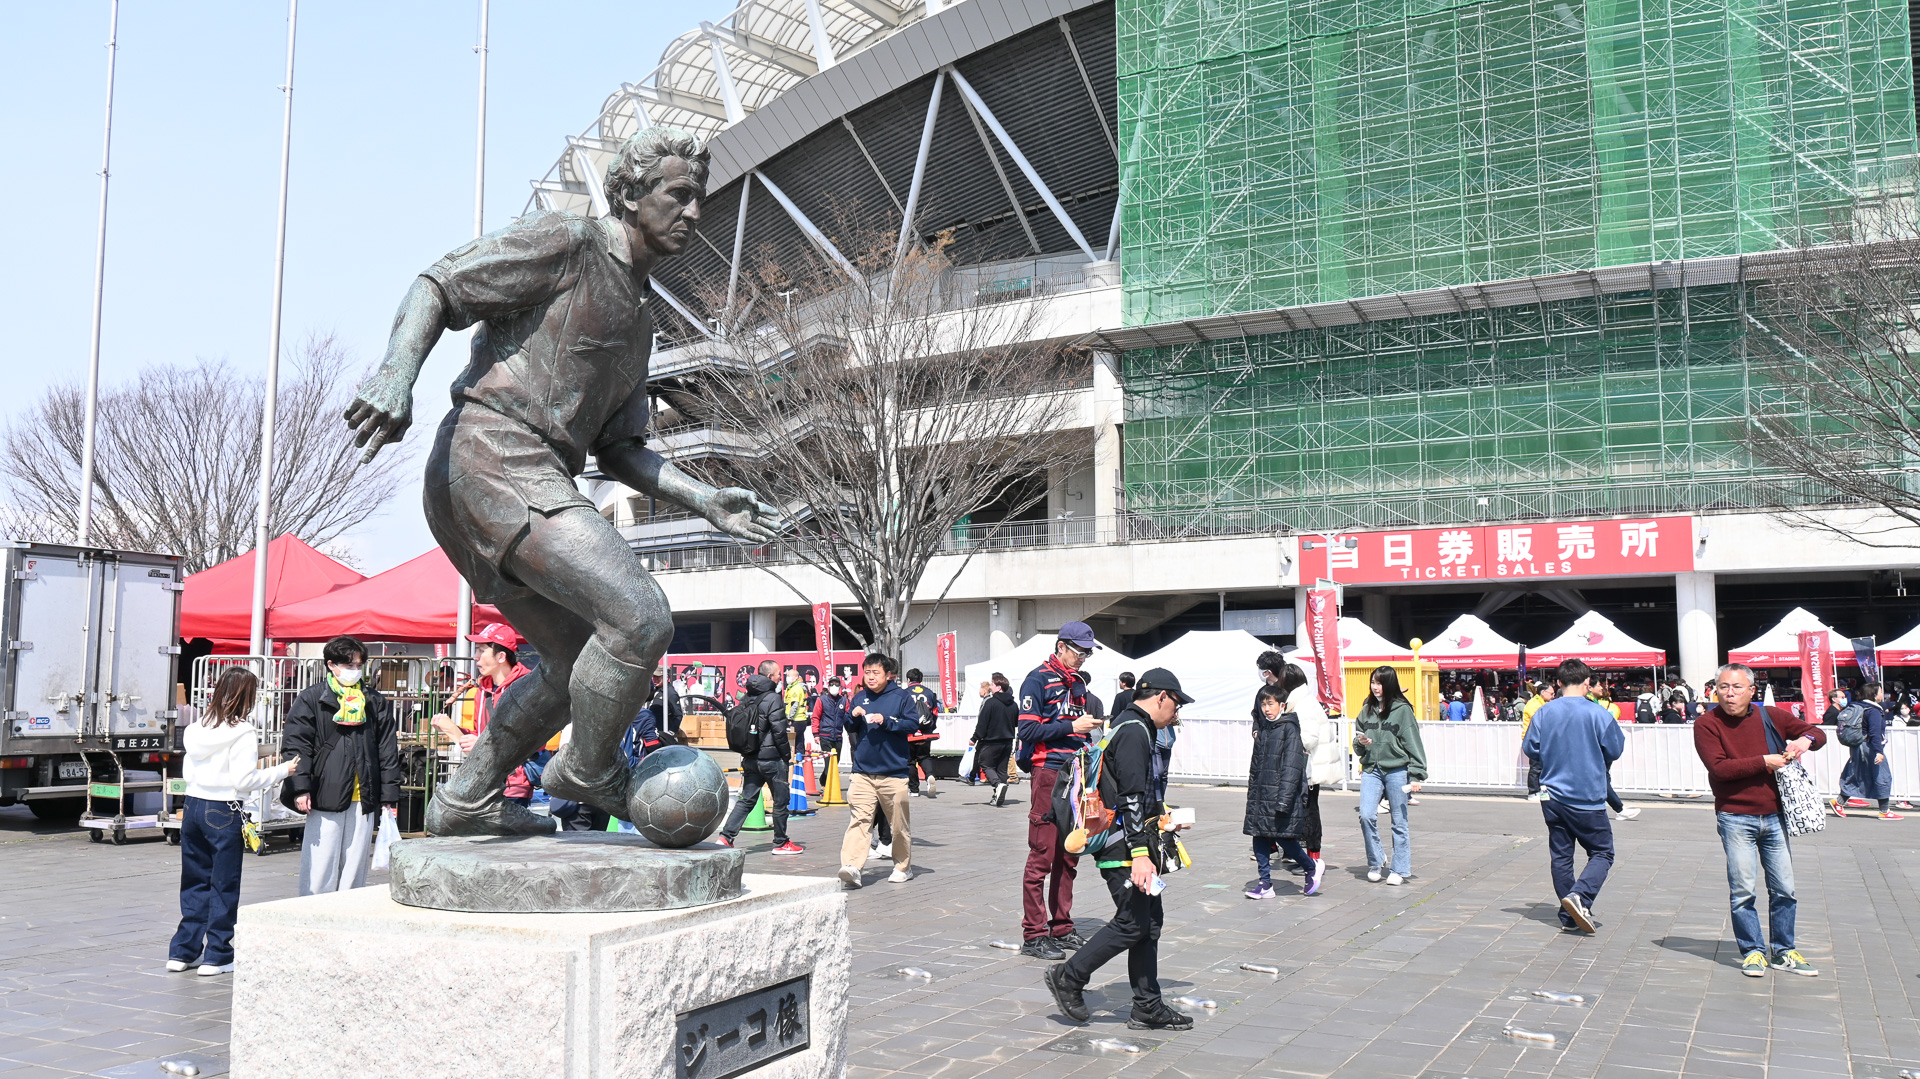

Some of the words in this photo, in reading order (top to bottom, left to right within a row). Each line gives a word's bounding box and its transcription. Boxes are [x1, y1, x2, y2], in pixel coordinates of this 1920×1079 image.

[1330, 521, 1659, 569] 当日券販売所
[1401, 564, 1482, 579] TICKET
[1497, 561, 1573, 576] SALES
[117, 738, 160, 748] 高圧ガス
[681, 992, 803, 1077] ジーコ像
